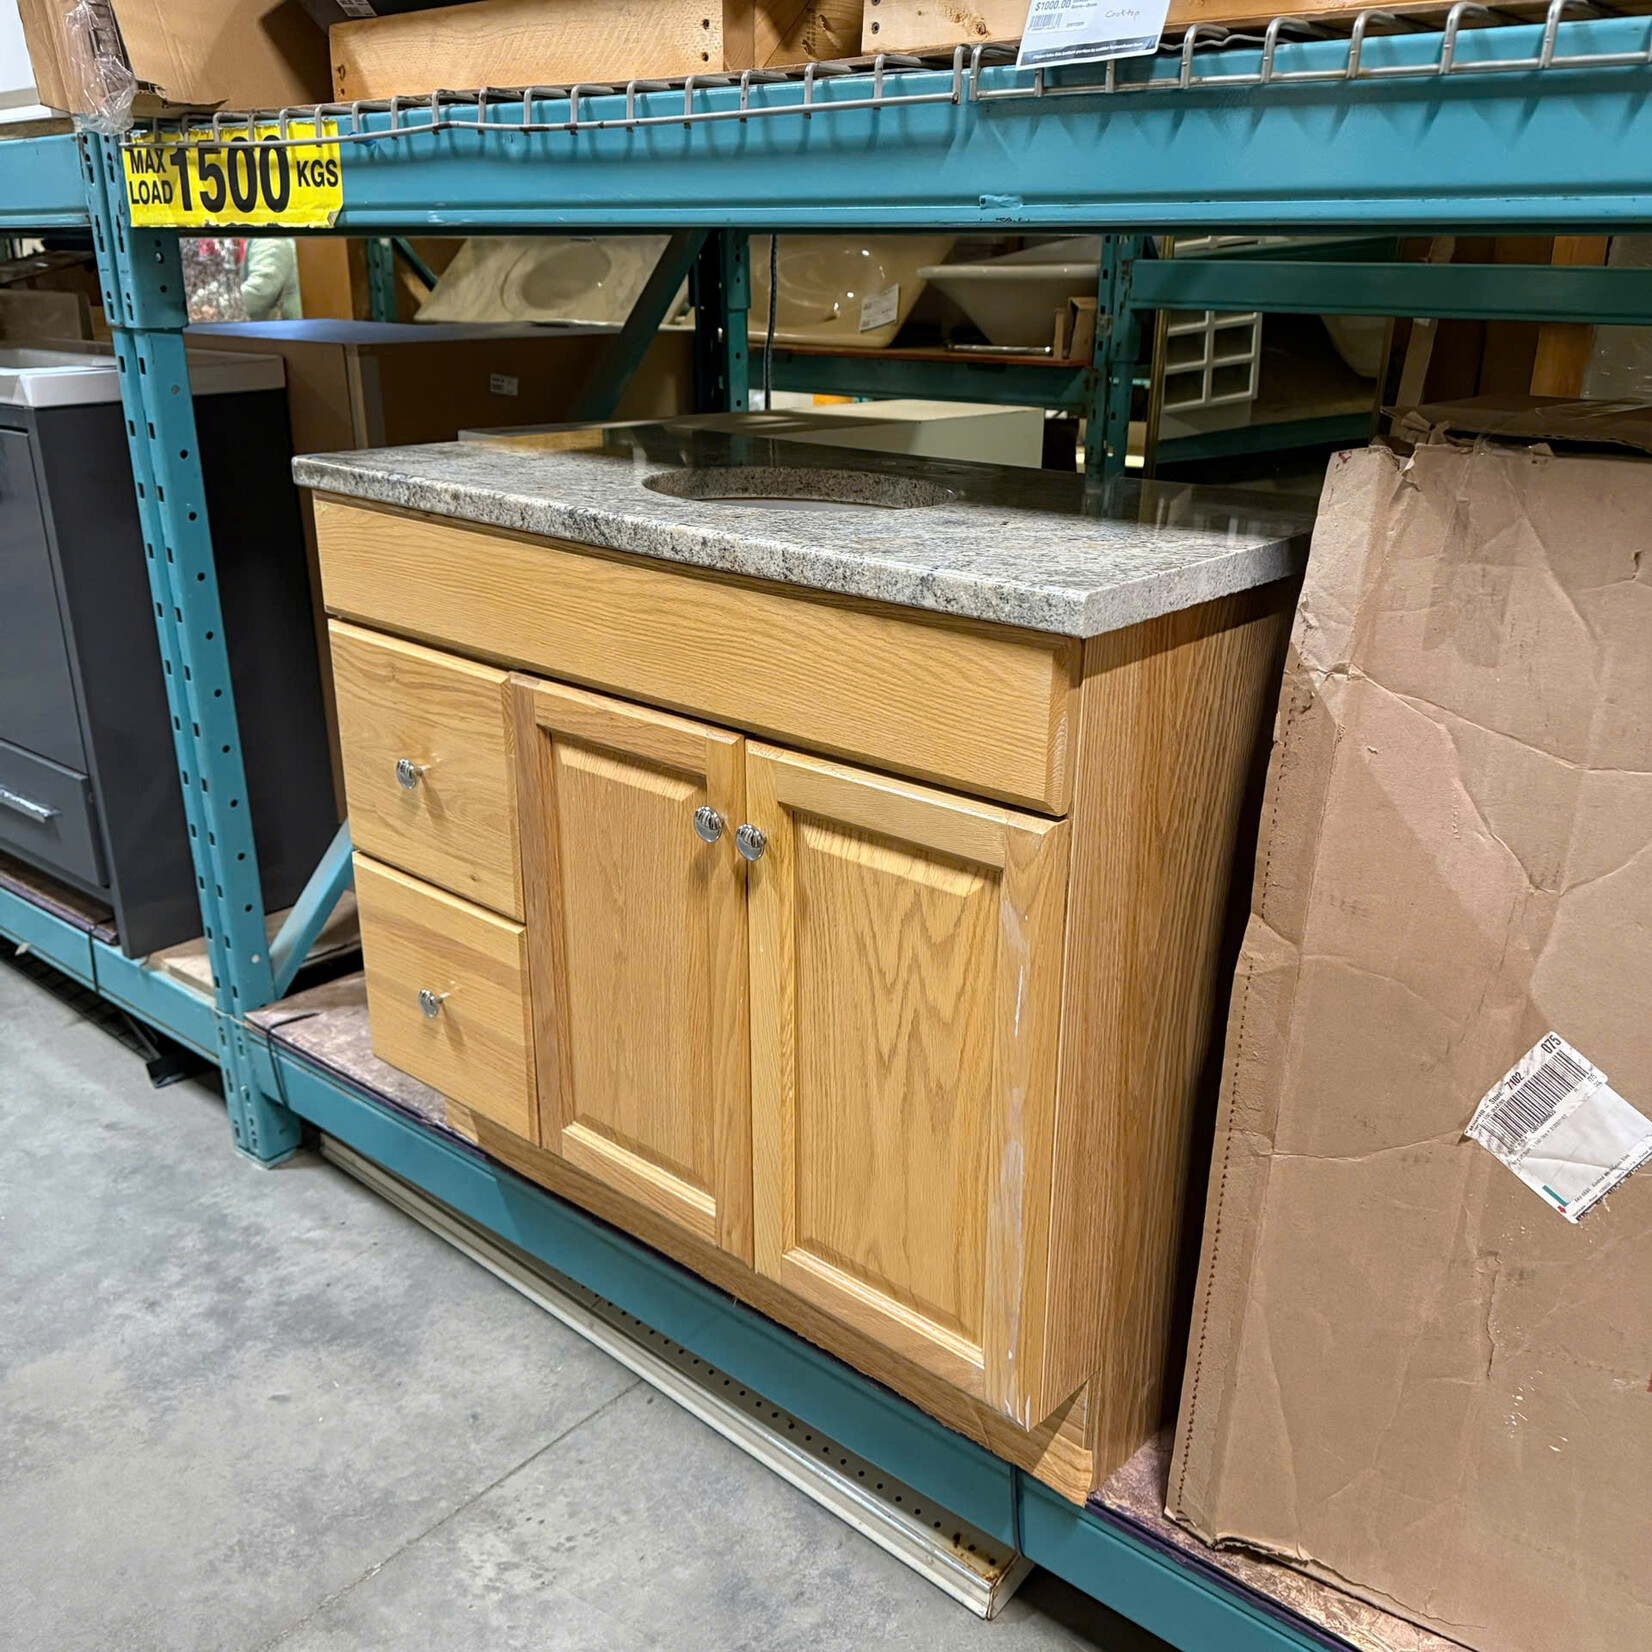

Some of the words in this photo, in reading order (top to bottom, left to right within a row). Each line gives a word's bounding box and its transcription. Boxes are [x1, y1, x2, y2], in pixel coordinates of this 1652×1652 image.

[1035, 0, 1071, 11] $1000.00
[125, 147, 167, 174] MAX
[169, 135, 290, 213] 1500
[297, 159, 339, 187] KGS
[129, 180, 174, 205] LOAD
[1504, 1071, 1525, 1090] 7102
[1540, 1034, 1562, 1054] 075
